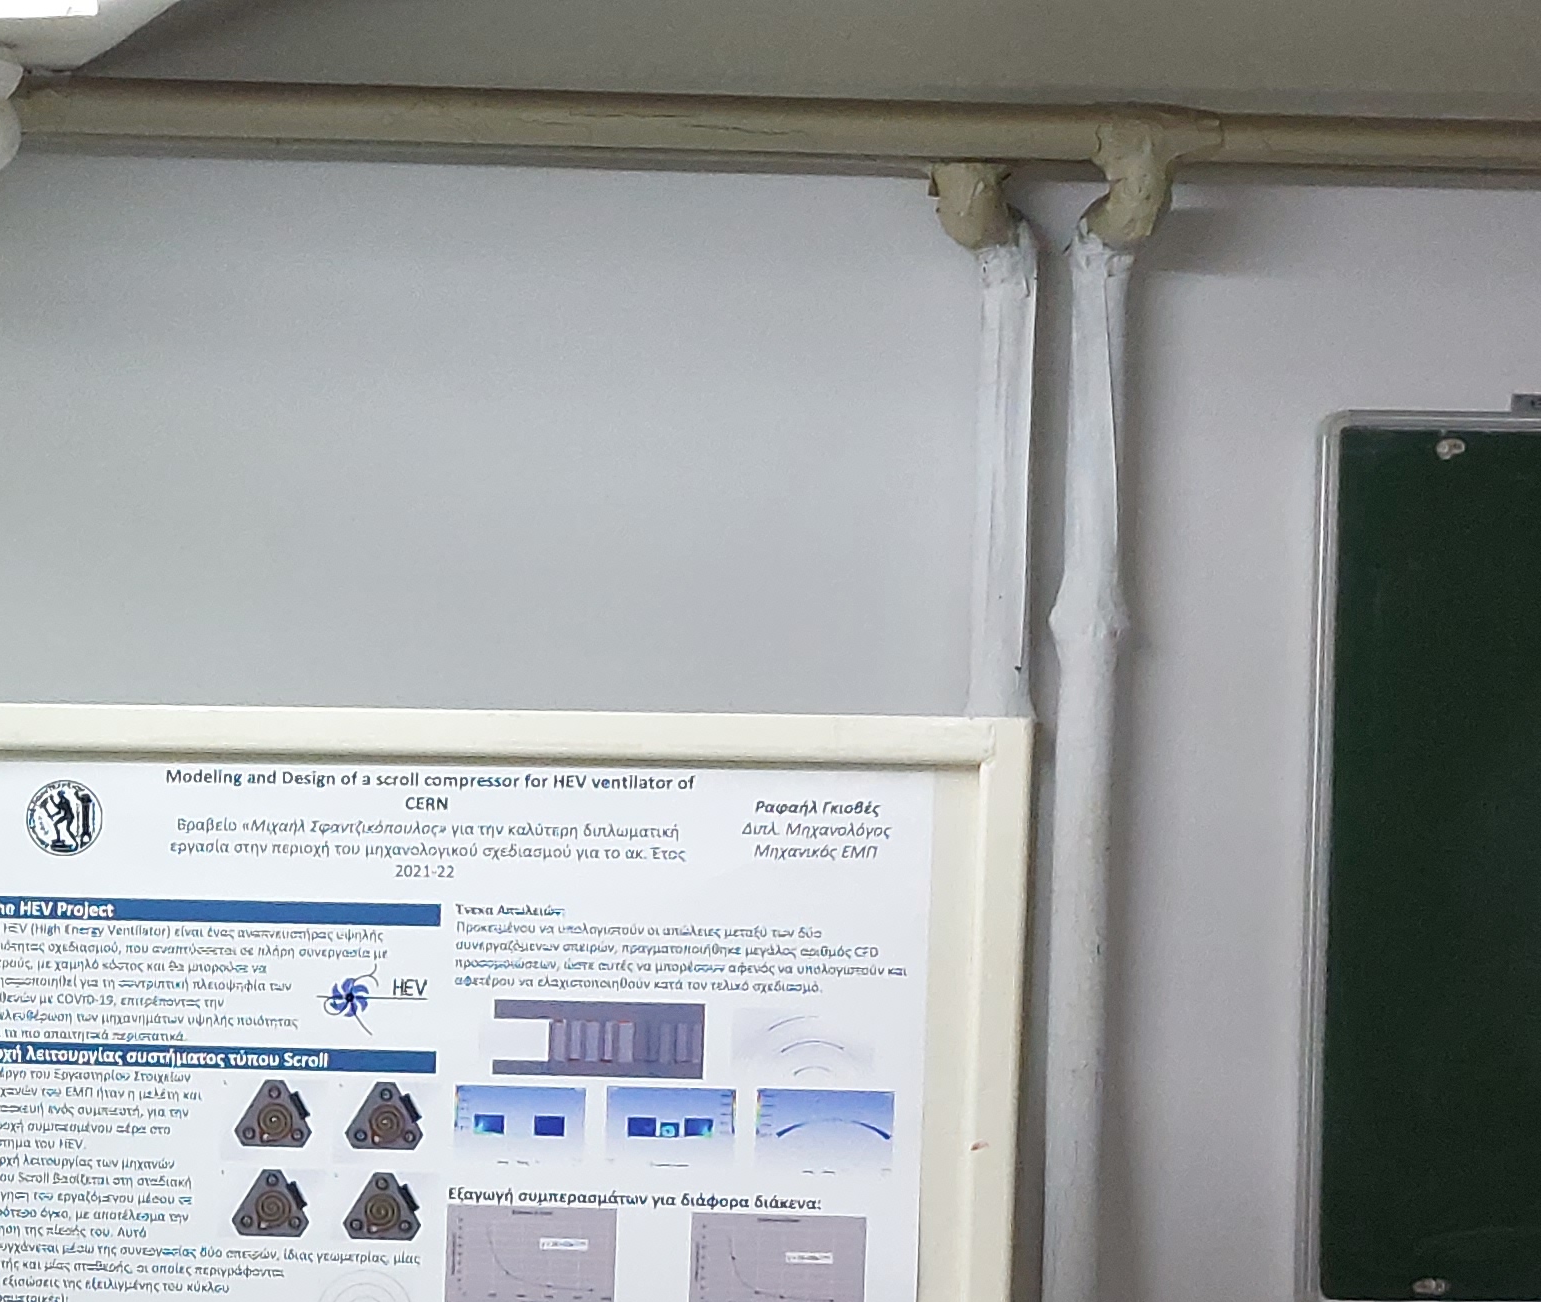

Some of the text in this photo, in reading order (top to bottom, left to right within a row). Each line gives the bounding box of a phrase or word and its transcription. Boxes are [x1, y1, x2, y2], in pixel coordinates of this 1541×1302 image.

[165, 768, 696, 791] Modeling and Design of a scroll compressor for HEV ventilator of
[405, 796, 449, 812] CERN
[754, 799, 882, 818] Ραφαήλ Γκιοβές
[242, 818, 306, 837] «Μιχαήλ
[309, 819, 447, 838] Σφαντζικόπουλος»
[451, 824, 475, 839] για
[477, 824, 505, 839] την
[507, 821, 579, 840] καλύτερη
[583, 822, 679, 843] διπλωματική
[785, 821, 893, 841] Μηχανολόγος
[170, 837, 230, 855] εργασία
[233, 842, 268, 857] στην
[271, 840, 330, 858] περιοχή
[334, 844, 361, 856] του
[365, 841, 478, 861] μηχανολογικού
[482, 842, 572, 862] σχεδιασμού
[575, 848, 600, 862] για
[603, 848, 621, 860] το
[753, 843, 879, 862] Μηχανικός ΕΜΠ
[394, 864, 455, 879] 2021-22
[19, 899, 54, 916] HEV
[56, 900, 115, 920] Project
[125, 944, 149, 955] που
[388, 977, 428, 999] HEV
[25, 1044, 124, 1065] λειτουργίας
[125, 1047, 226, 1068] συστήματος
[227, 1049, 280, 1067] τύπου
[283, 1051, 329, 1069] Scroll
[447, 1186, 516, 1208] Εξαγωγή
[515, 1189, 649, 1211] συμπερασμάτων
[650, 1195, 677, 1210] για
[680, 1191, 750, 1211] διάφορα
[753, 1194, 822, 1211] διάκενα:
